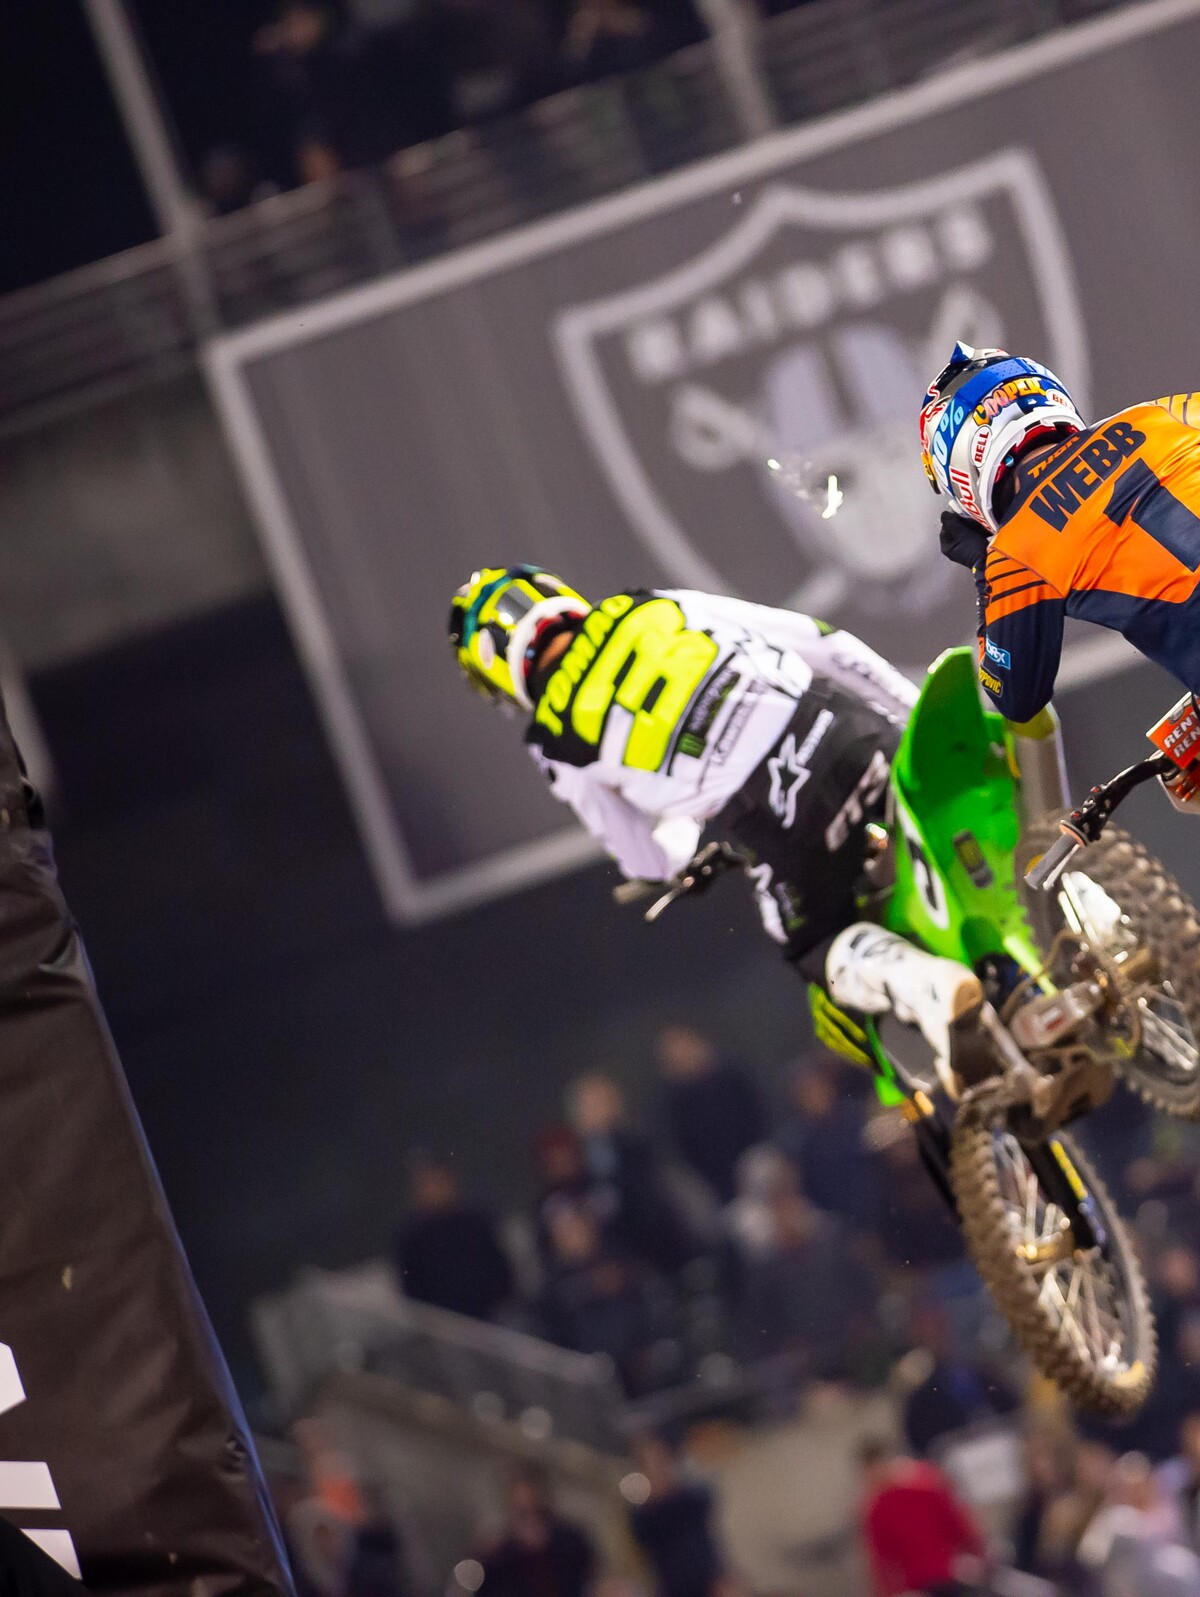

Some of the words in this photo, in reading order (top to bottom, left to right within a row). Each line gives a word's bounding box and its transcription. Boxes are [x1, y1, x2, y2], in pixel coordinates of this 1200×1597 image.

[624, 203, 993, 386] RAIDERS
[972, 376, 1046, 427] COOPER
[974, 431, 989, 463] BELL
[1027, 436, 1080, 479] THOR
[1028, 421, 1147, 533] WEBB
[571, 597, 719, 773] 3
